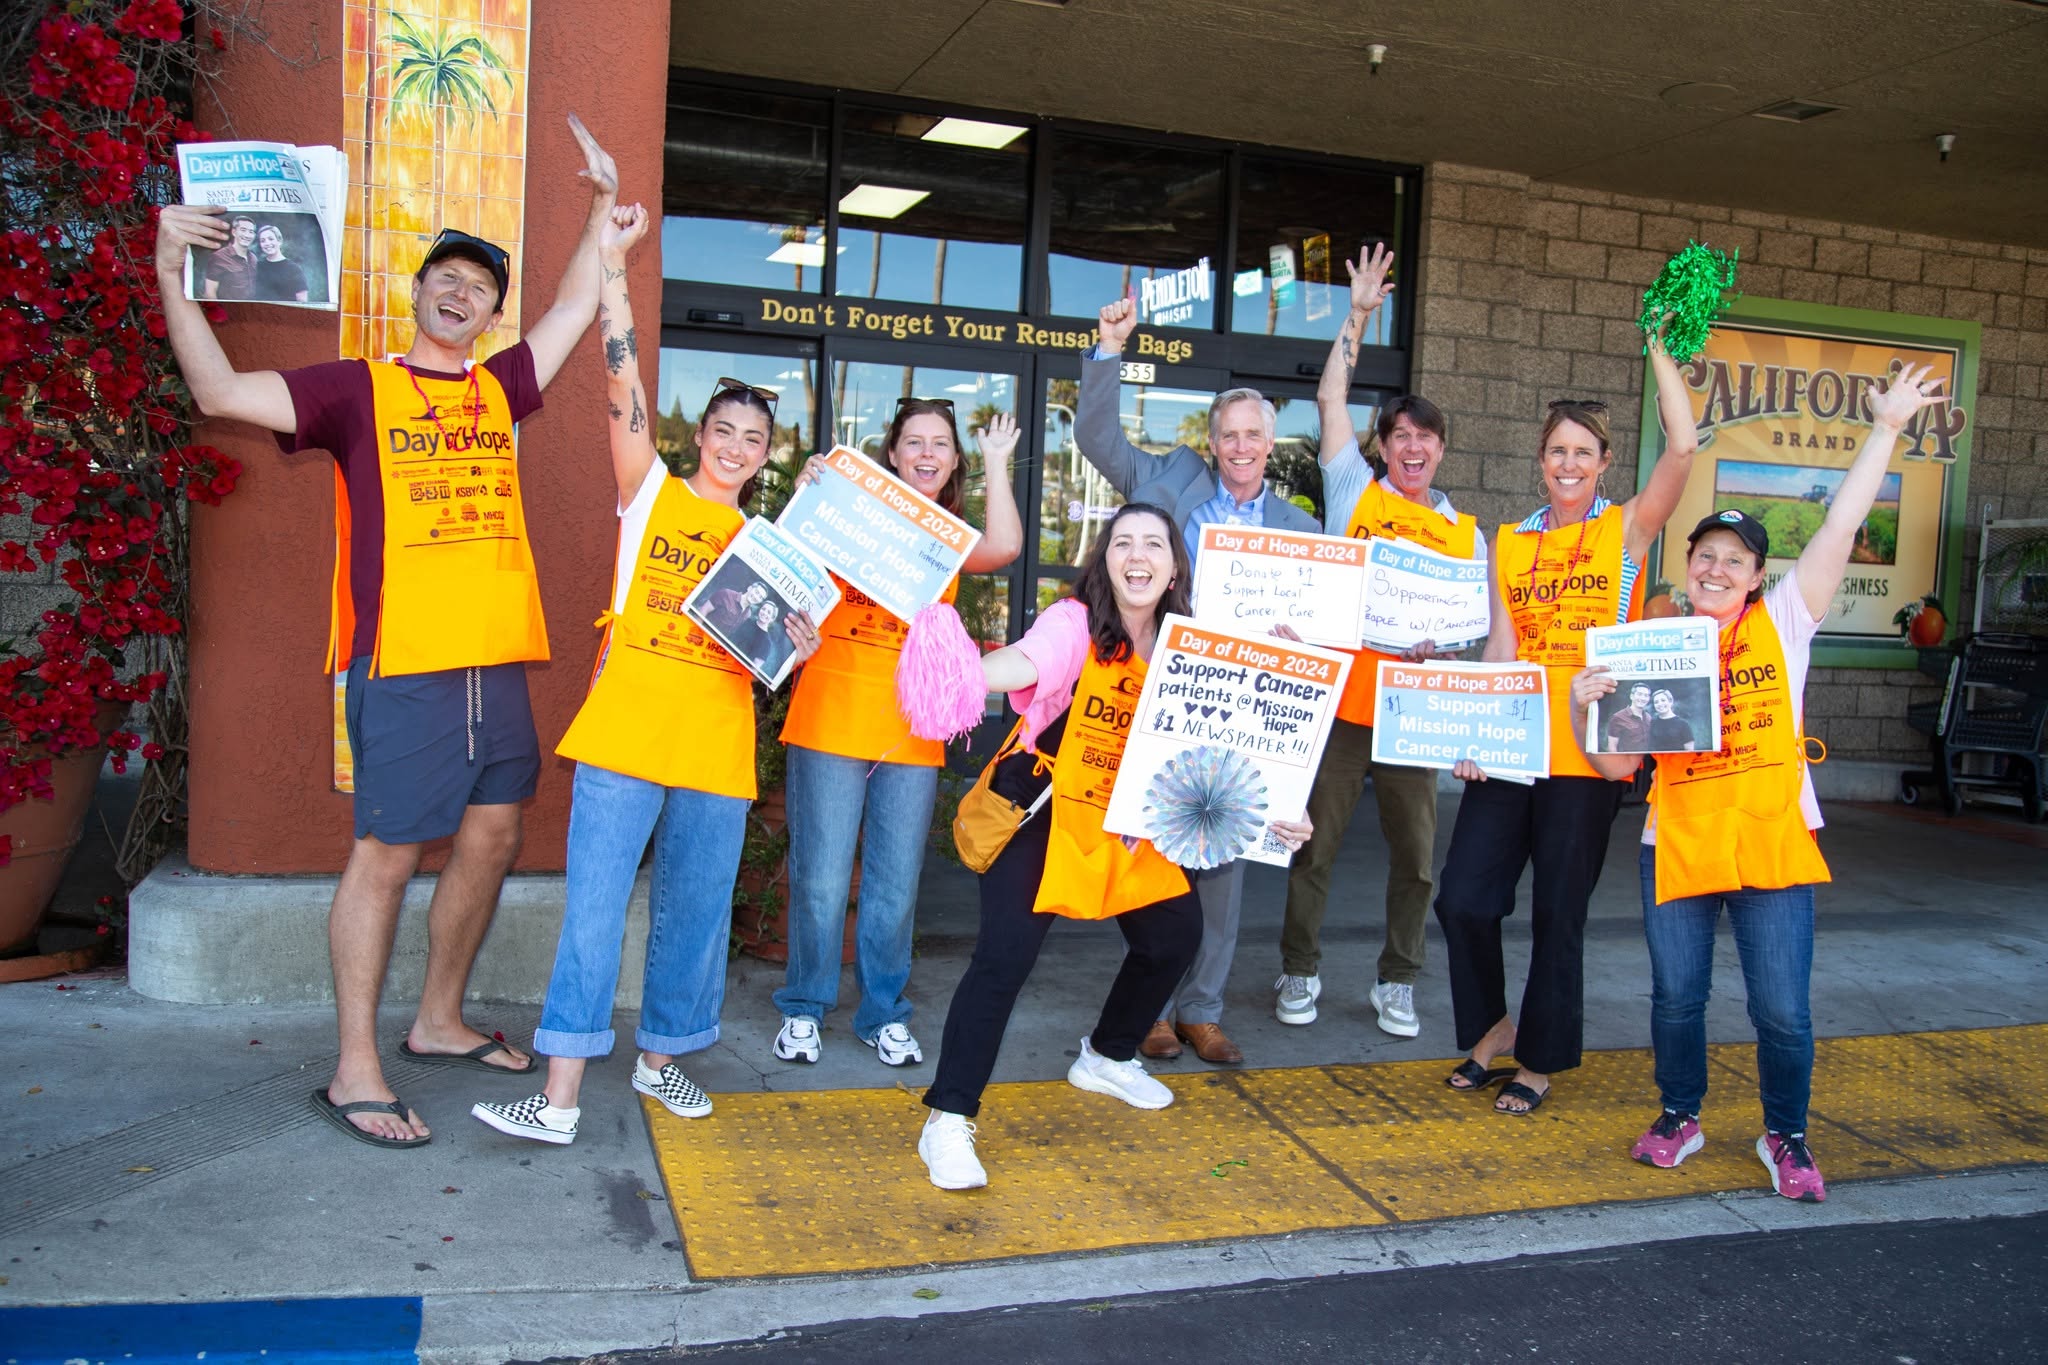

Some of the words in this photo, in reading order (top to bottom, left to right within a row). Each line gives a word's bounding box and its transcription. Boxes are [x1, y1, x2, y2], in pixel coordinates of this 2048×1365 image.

[189, 156, 221, 179] Day
[225, 155, 240, 173] of
[241, 152, 280, 175] Hope
[206, 189, 236, 199] SANTA
[251, 187, 302, 204] TIMES
[1141, 256, 1210, 318] PENDLETON
[1154, 304, 1193, 326] WHISKY
[761, 298, 836, 327] Don't
[847, 306, 934, 339] Forget
[944, 315, 1007, 342] Your
[1137, 333, 1193, 363] Bags
[389, 427, 440, 457] Day
[462, 426, 511, 455] Hope
[1772, 430, 1857, 451] BRAND
[455, 486, 477, 498] KSBY
[835, 454, 865, 482] Day
[865, 475, 883, 493] of
[882, 485, 923, 518] Hope
[920, 511, 964, 546] 2024
[852, 494, 920, 548] Support
[649, 535, 696, 573] Day
[697, 556, 719, 576] o
[753, 525, 776, 547] Day
[776, 543, 790, 557] of
[788, 550, 819, 583] Hope
[814, 500, 880, 553] Mission
[881, 547, 926, 585] Hope
[928, 540, 944, 558] $1
[1215, 533, 1244, 551] Day
[1247, 536, 1266, 550] of
[1269, 537, 1309, 558] Hope
[1313, 545, 1357, 562] 2024
[799, 520, 860, 569] Cancer
[859, 563, 916, 608] Center
[1230, 560, 1282, 581] Donate
[1298, 567, 1315, 587] $1
[1379, 547, 1401, 566] Day
[1403, 556, 1416, 569] of
[1418, 558, 1452, 578] Hope
[780, 572, 814, 612] TIMES
[1274, 585, 1302, 598] Local
[1537, 579, 1559, 600] of
[1234, 602, 1277, 619] Cancer
[1288, 603, 1315, 618] Care
[1596, 636, 1625, 651] Day
[1625, 634, 1640, 647] of
[1642, 632, 1681, 649] Hope
[1179, 631, 1212, 656] Day
[1215, 641, 1233, 656] of
[1236, 645, 1280, 668] Hope
[1283, 656, 1329, 680] 2024
[1608, 658, 1632, 667] SANTA
[1647, 657, 1697, 672] TIMES
[1166, 653, 1248, 686] Support
[1254, 672, 1327, 702] Cancer
[1393, 671, 1422, 688] Day
[1427, 674, 1442, 687] of
[1447, 675, 1488, 693] Hope
[1493, 675, 1535, 691] 2024
[1719, 664, 1776, 692] Hope
[1083, 694, 1120, 731] Day
[1118, 709, 1135, 730] o
[1236, 694, 1252, 710] @
[1253, 698, 1313, 723] Mission
[1384, 694, 1408, 717] $1
[1427, 695, 1501, 719] Support
[1506, 698, 1533, 721] $1
[1152, 707, 1175, 732] $1
[1182, 719, 1285, 755] NEWSPAPER
[1263, 717, 1298, 735] Hope
[1399, 715, 1471, 737] Mission
[1478, 722, 1527, 743] Hope
[1395, 738, 1463, 759] Cancer
[1466, 744, 1529, 765] Center
